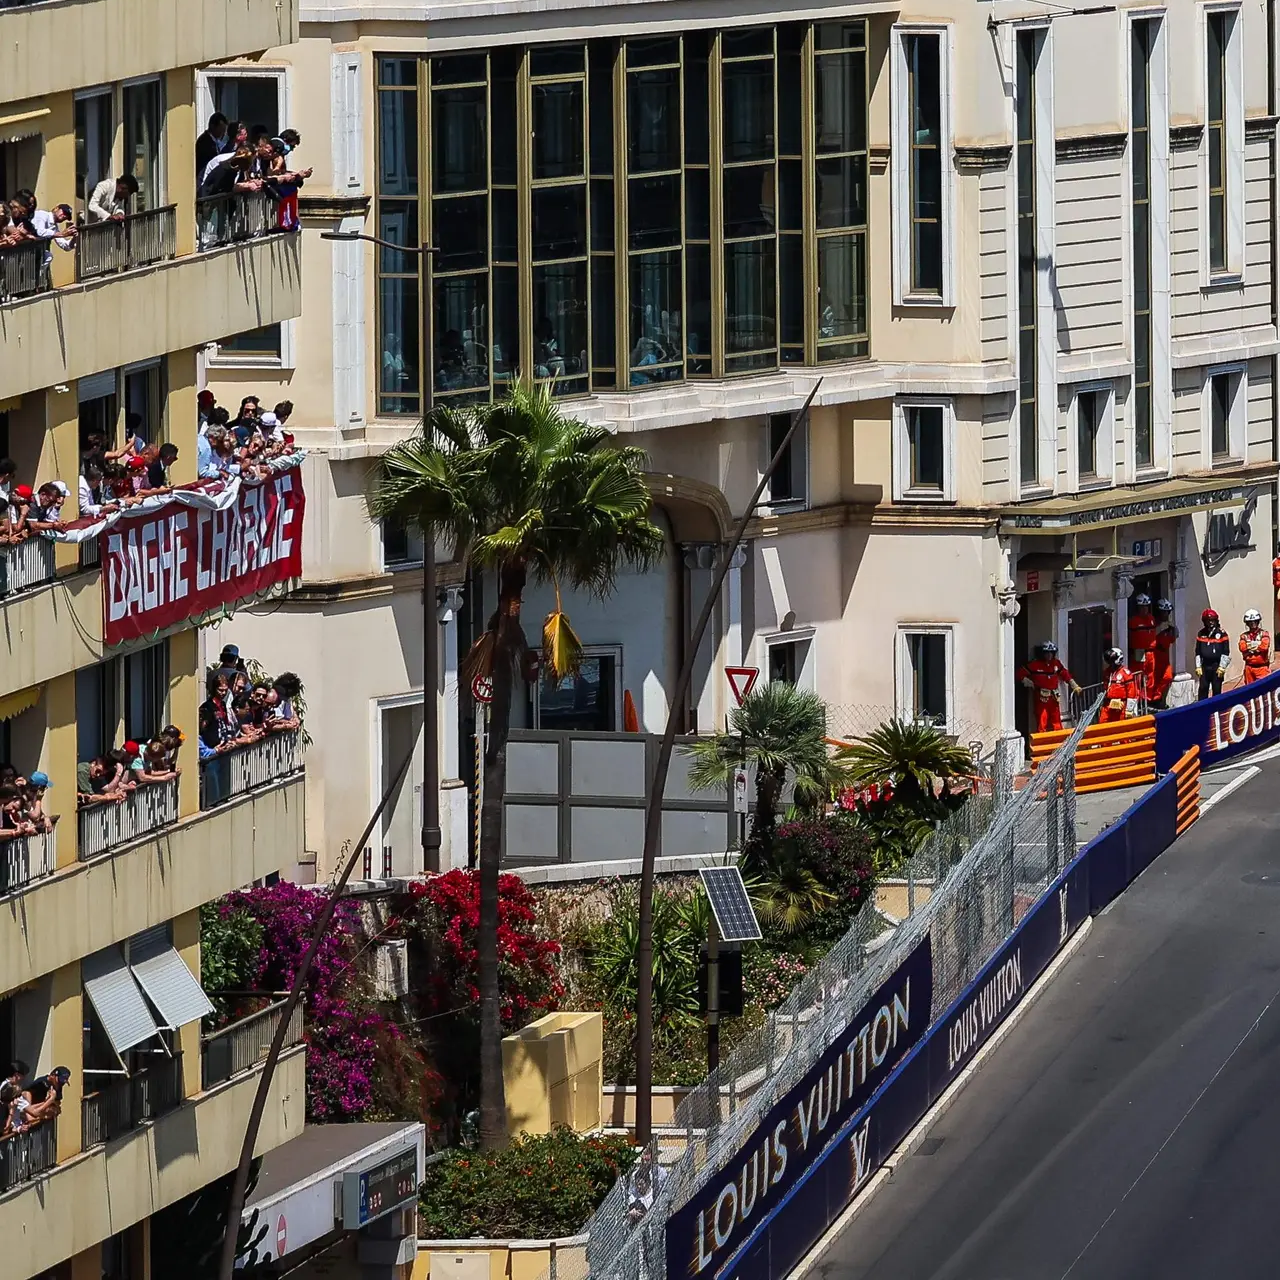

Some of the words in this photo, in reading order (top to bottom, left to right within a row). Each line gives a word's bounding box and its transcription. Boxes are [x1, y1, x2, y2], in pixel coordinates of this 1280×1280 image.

[108, 511, 189, 622] DAGHE
[197, 475, 295, 590] CHARLIE
[949, 1013, 978, 1071] LOUIS
[979, 948, 1022, 1031] VUITTON
[698, 1120, 788, 1272] LOUIS
[797, 976, 911, 1151] VUITTON
